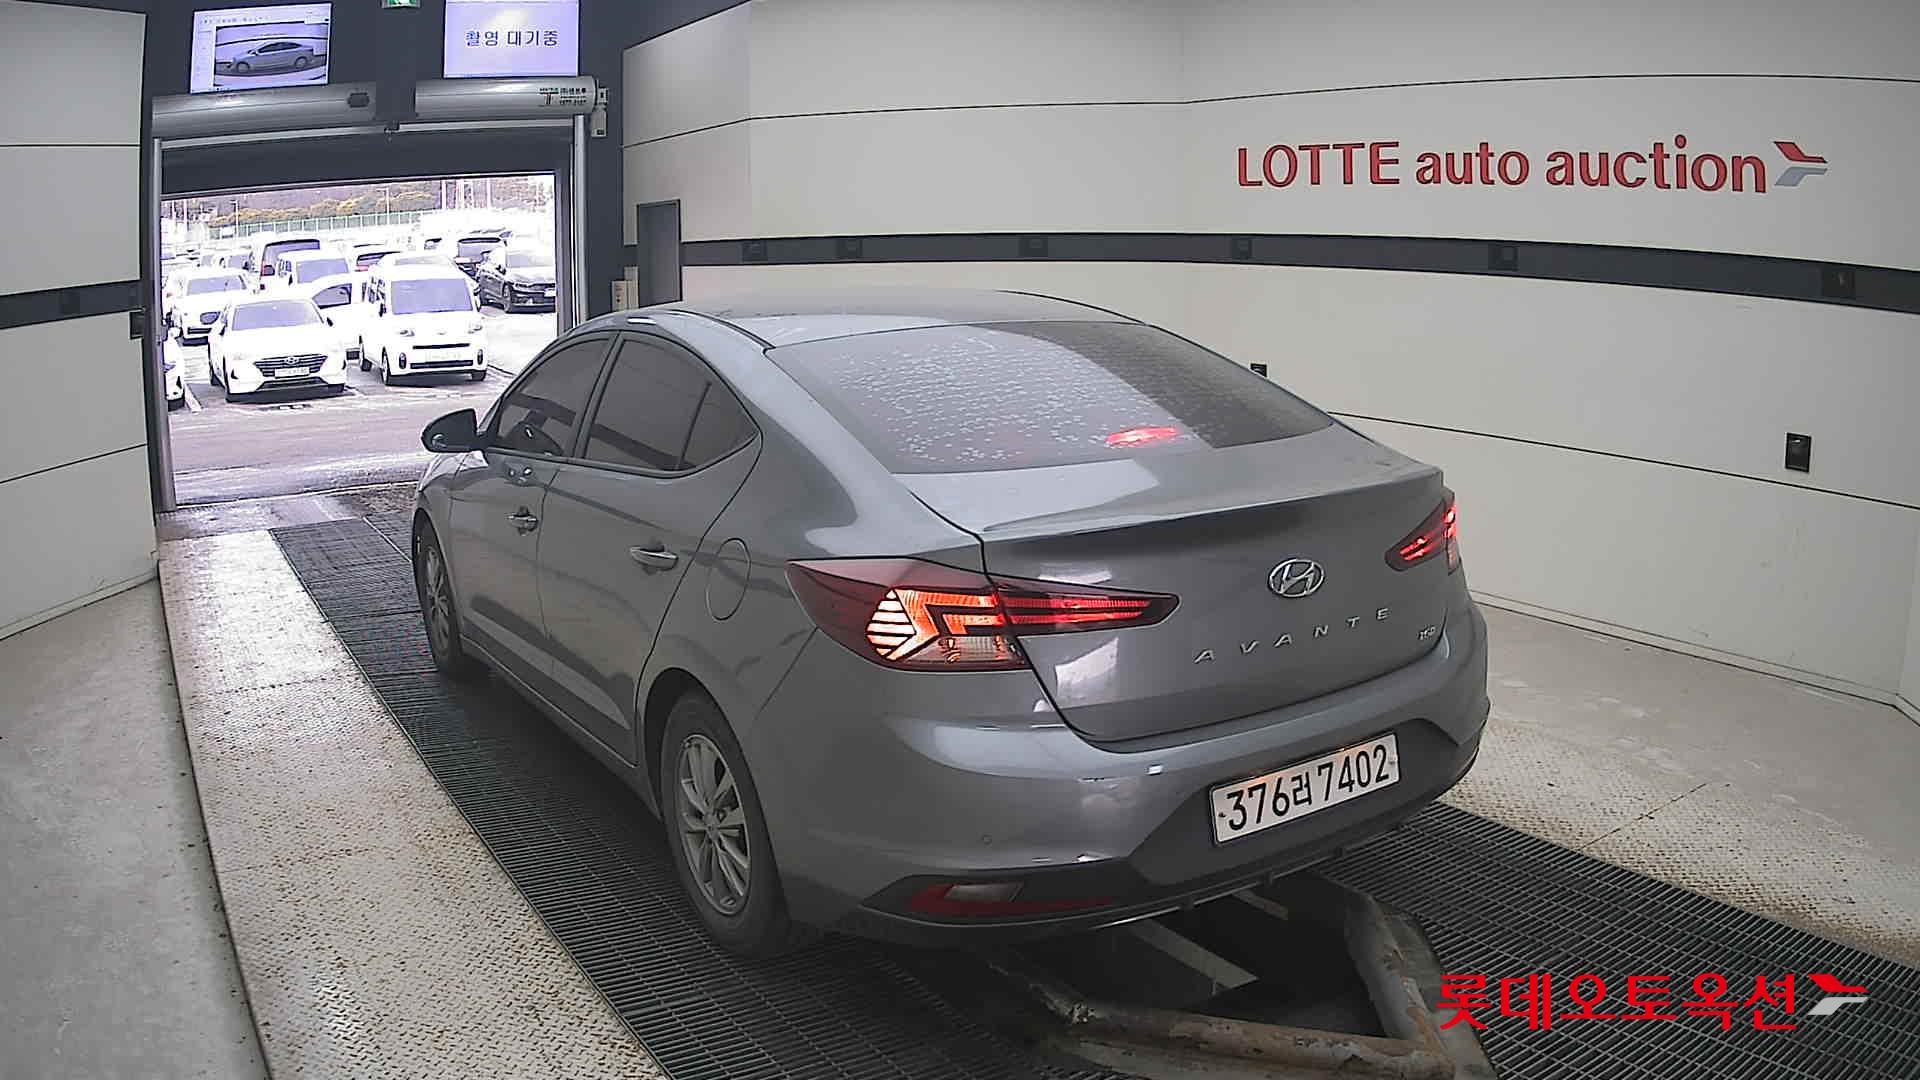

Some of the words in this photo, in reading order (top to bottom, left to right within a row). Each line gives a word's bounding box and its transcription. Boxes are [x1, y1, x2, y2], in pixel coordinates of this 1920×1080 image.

[465, 29, 499, 47] 촬영
[507, 29, 559, 47] 대기중
[1238, 141, 1400, 188] LOTTE
[1415, 141, 1530, 187] auto
[1545, 134, 1767, 194] auction
[1193, 607, 1390, 664] AVANTE
